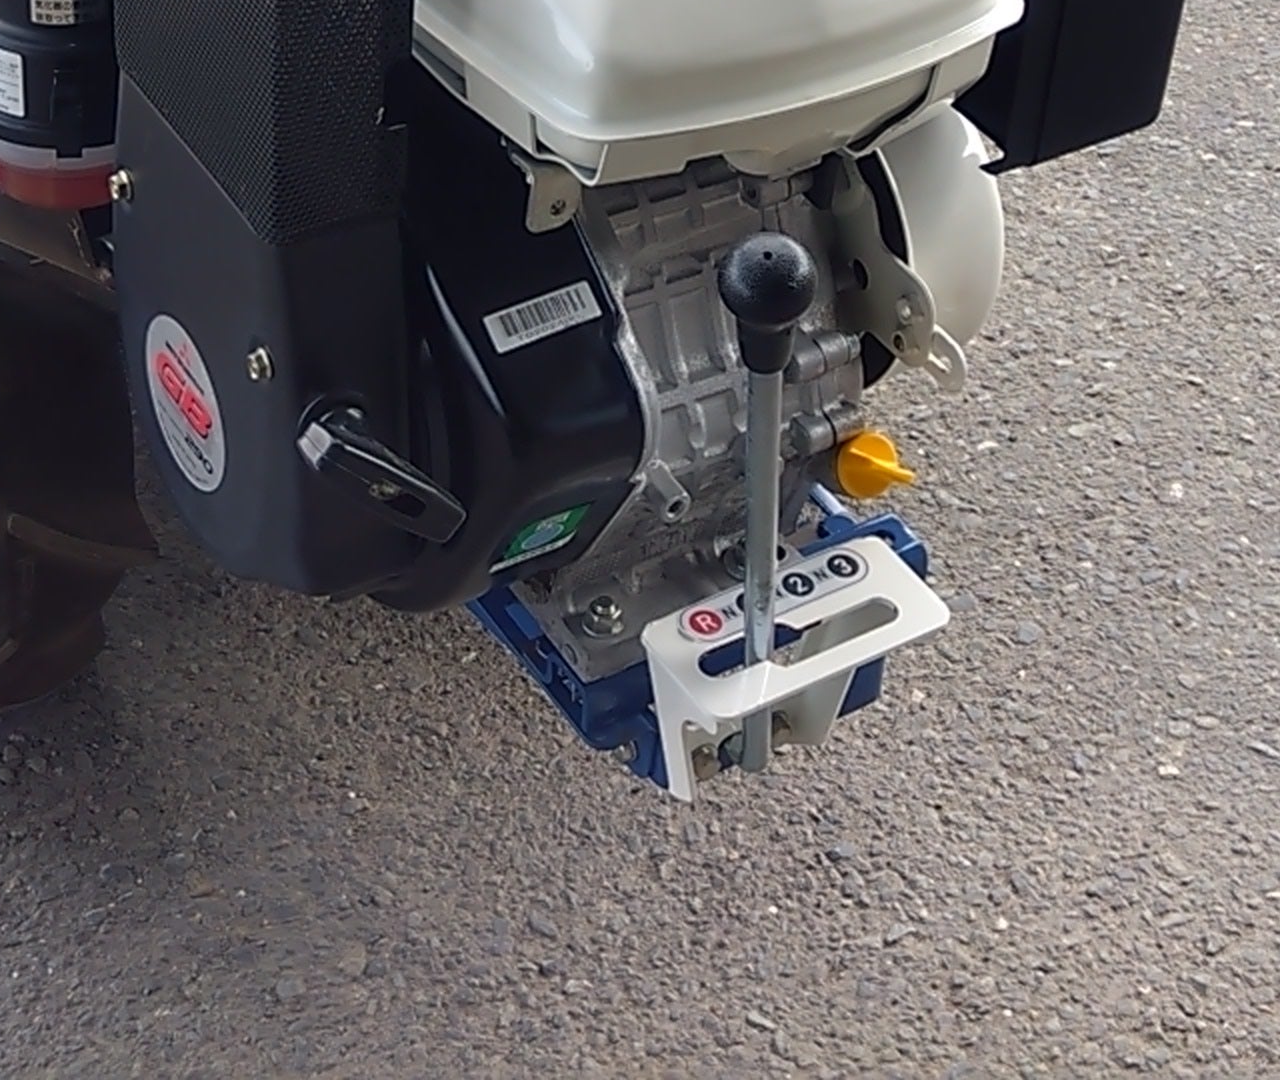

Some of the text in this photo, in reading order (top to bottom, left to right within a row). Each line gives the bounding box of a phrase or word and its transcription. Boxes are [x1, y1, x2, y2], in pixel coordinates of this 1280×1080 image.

[155, 352, 213, 440] GB
[722, 607, 738, 619] N
[813, 570, 830, 582] N
